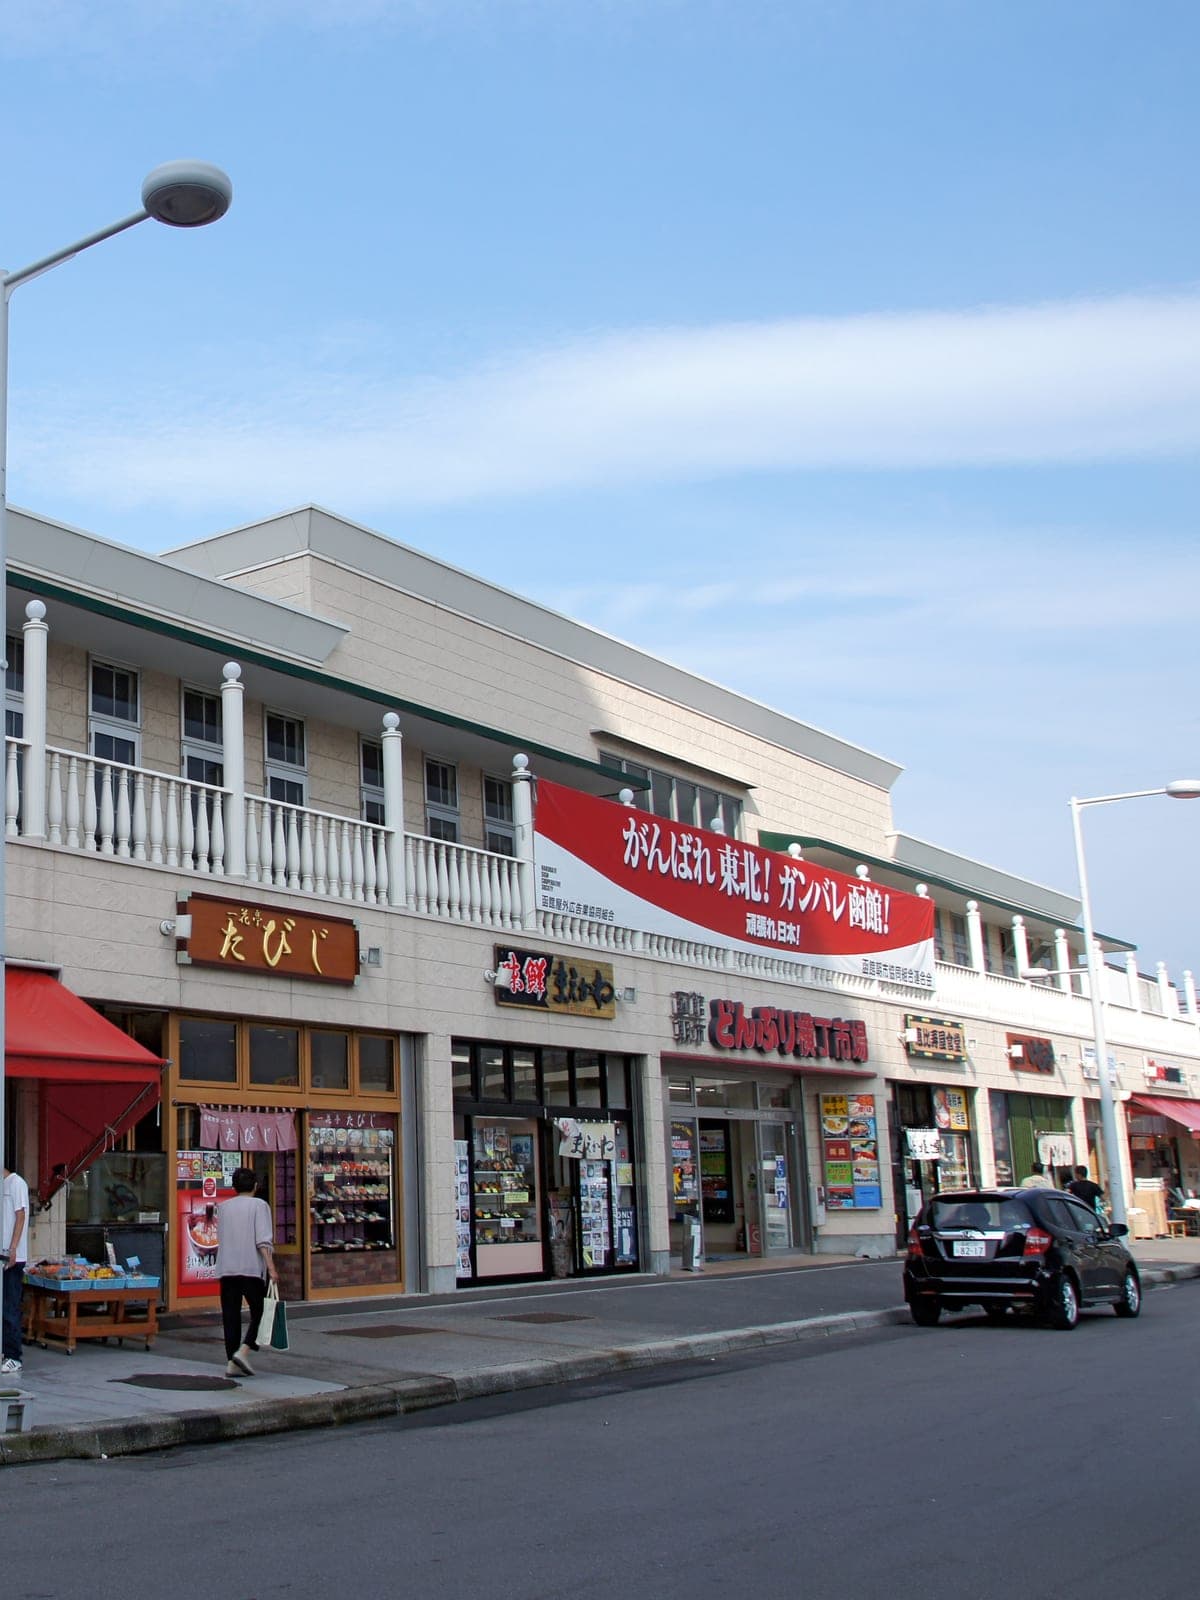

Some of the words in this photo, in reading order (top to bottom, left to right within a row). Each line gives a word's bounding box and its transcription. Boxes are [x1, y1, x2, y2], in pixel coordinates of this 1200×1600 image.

[220, 918, 329, 974] たびじ
[712, 999, 868, 1062] どんぶり横丁市場
